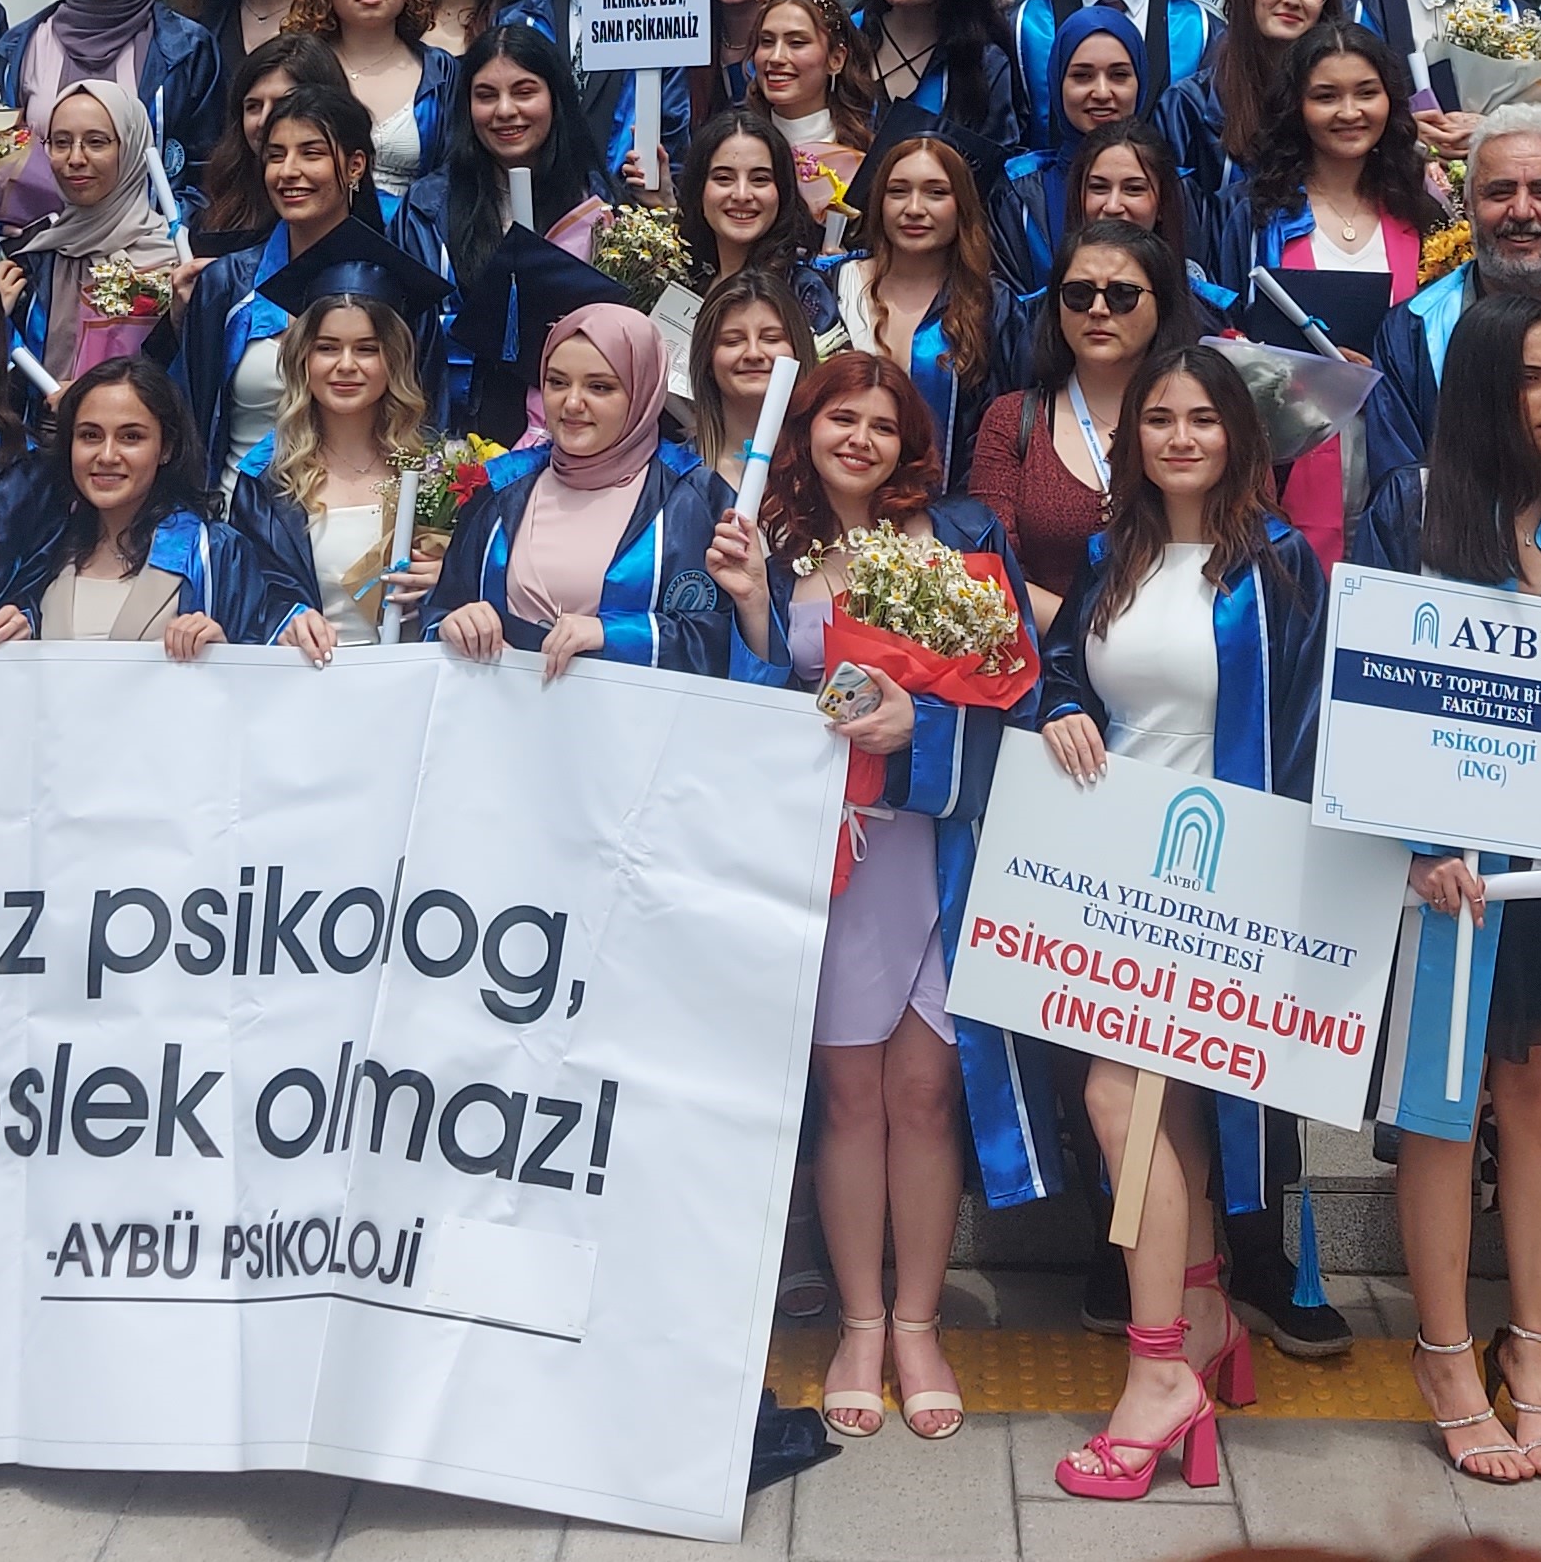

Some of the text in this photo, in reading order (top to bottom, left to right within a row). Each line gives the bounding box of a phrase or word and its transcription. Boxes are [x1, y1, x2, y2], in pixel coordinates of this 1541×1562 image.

[591, 11, 699, 43] SANA PSİKANALİZ
[1362, 657, 1417, 684] İNSAN
[1419, 669, 1442, 689] VE
[1445, 674, 1521, 701] TOPLUM
[1441, 695, 1534, 726] FAKÜLTESİ
[1430, 728, 1537, 766] PSİKOLOJİ
[1457, 754, 1507, 788] (İNG)
[1004, 856, 1358, 969] ANKARA YILDIRIM BEYAZIT
[1162, 872, 1202, 893] AYBÜ
[86, 855, 587, 1025] psikolog,
[1082, 901, 1265, 974] ÜNİVERSİTESİ
[969, 916, 1367, 1056] PSİKOLOJİ BÖLÜMÜ
[1041, 984, 1268, 1091] (İNGİLİZCE)
[255, 1040, 619, 1196] olmaz!
[220, 1208, 425, 1289] PSİKOLOJİ
